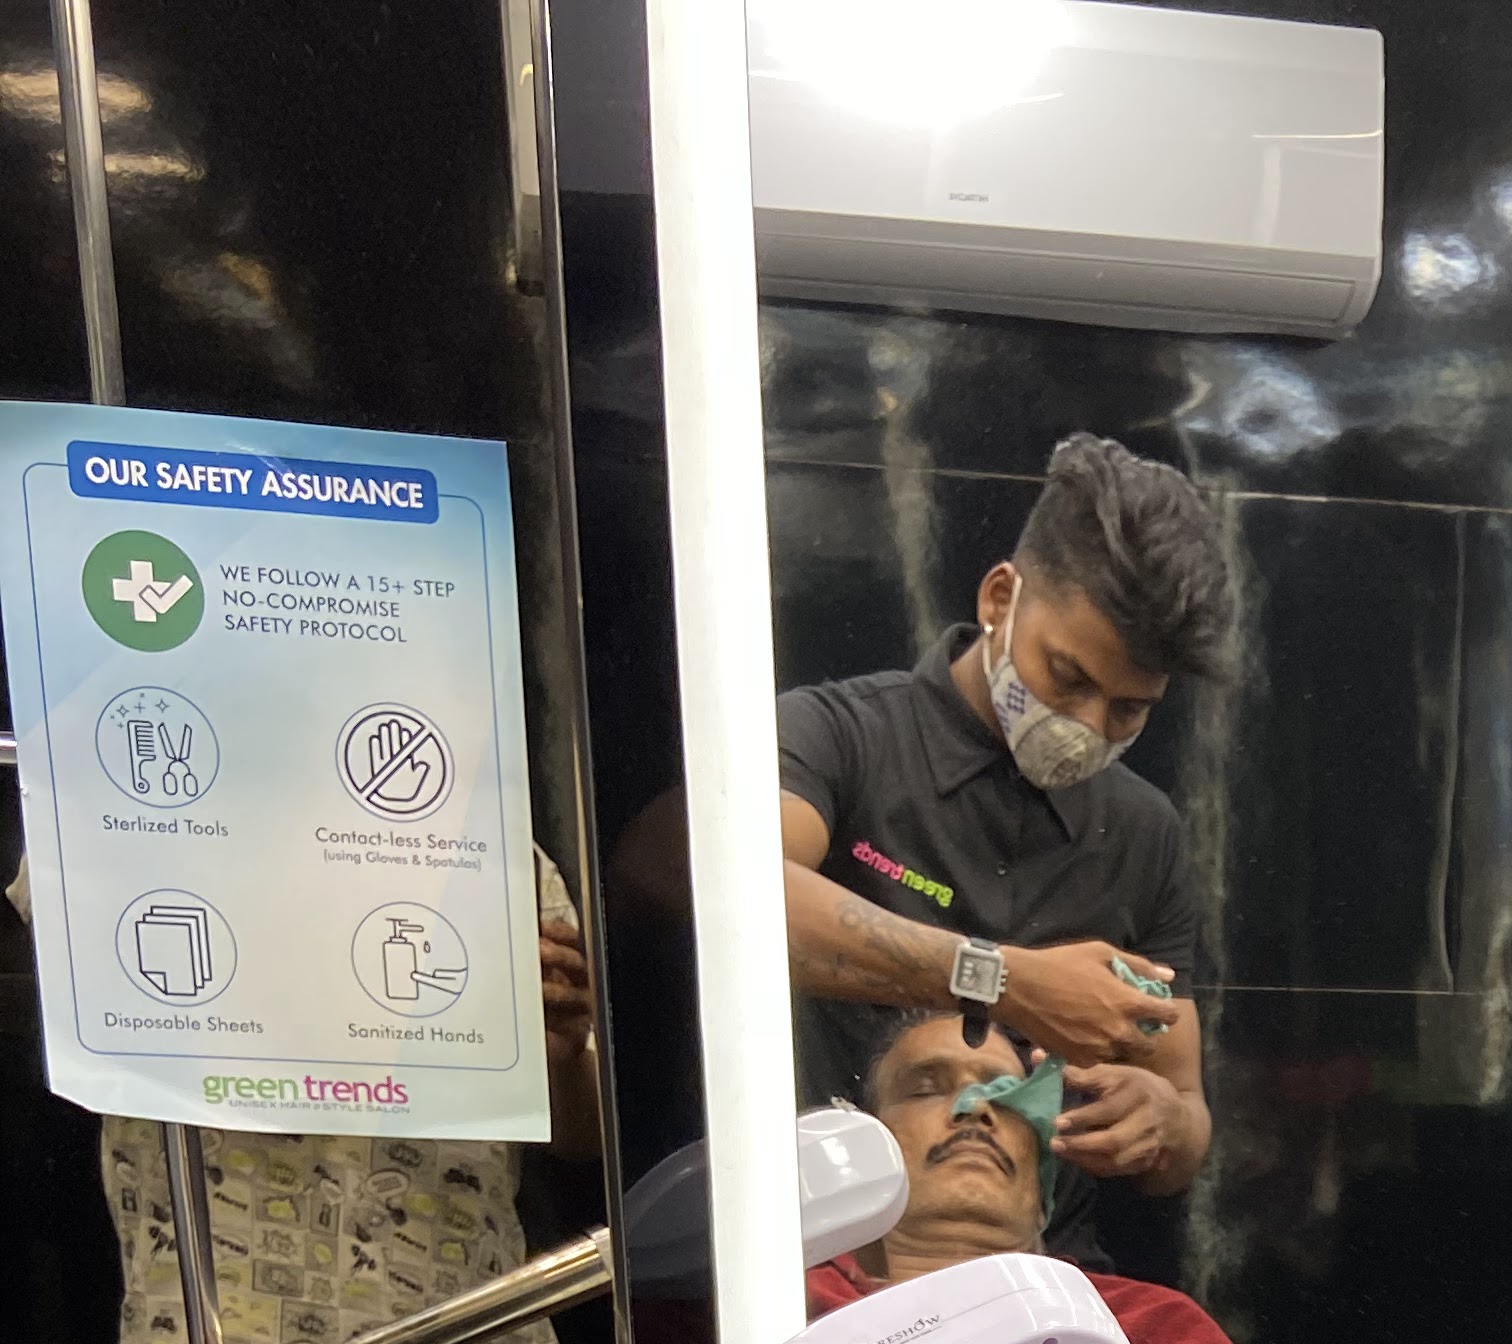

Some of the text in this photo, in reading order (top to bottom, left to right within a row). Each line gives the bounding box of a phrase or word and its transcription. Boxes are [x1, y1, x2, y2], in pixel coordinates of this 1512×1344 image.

[85, 456, 424, 509] OUR SAFETY ASSURANCE
[220, 564, 456, 598] WE FOLLOW A 15+ STEP
[222, 589, 401, 618] NO-COMPROMISE
[224, 614, 408, 643] SAFETY PROTOCOL
[102, 814, 229, 837] Sterlized Tools
[314, 826, 488, 853] Contact-less Service
[365, 851, 409, 866] Gloves
[103, 1011, 265, 1034] Disposable Sheets
[348, 1022, 485, 1044] Sanitized Hands
[202, 1074, 410, 1105] green trends
[322, 1102, 363, 1113] STYLE
